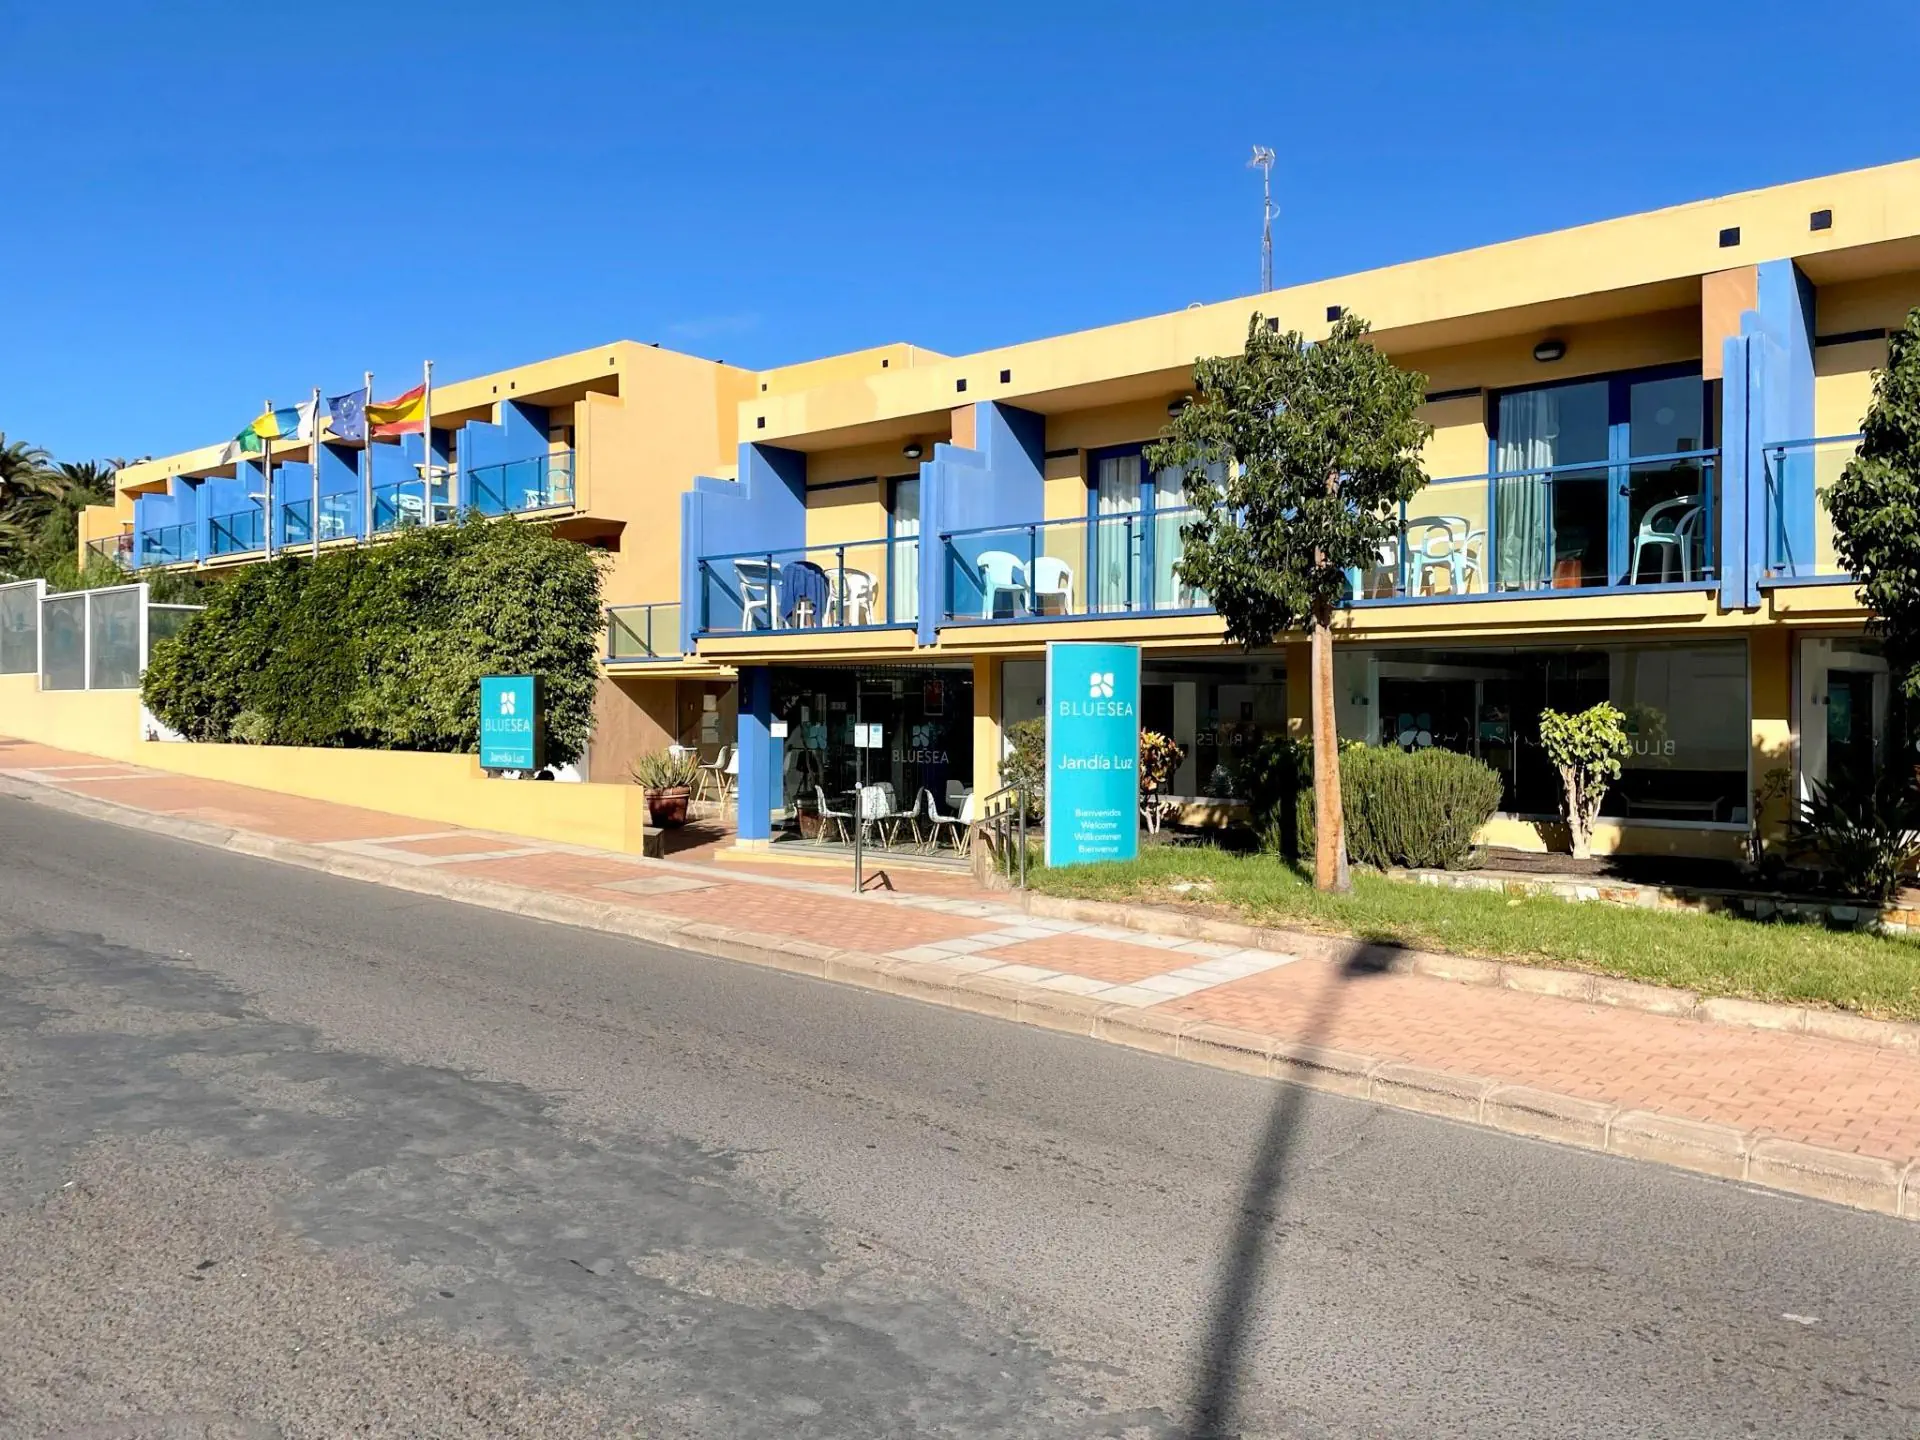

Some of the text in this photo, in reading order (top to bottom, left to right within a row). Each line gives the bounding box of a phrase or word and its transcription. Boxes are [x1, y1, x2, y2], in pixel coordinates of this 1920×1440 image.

[1060, 701, 1133, 716] BLUESEA
[485, 718, 530, 732] BLUESEA
[490, 752, 525, 763] Jandía Luz
[892, 749, 949, 764] BLUESEA
[1058, 753, 1133, 770] Jandía Luz
[1081, 820, 1118, 829] Welcome
[1073, 832, 1121, 841] Willkommen
[1078, 845, 1119, 853] Bienvenue
